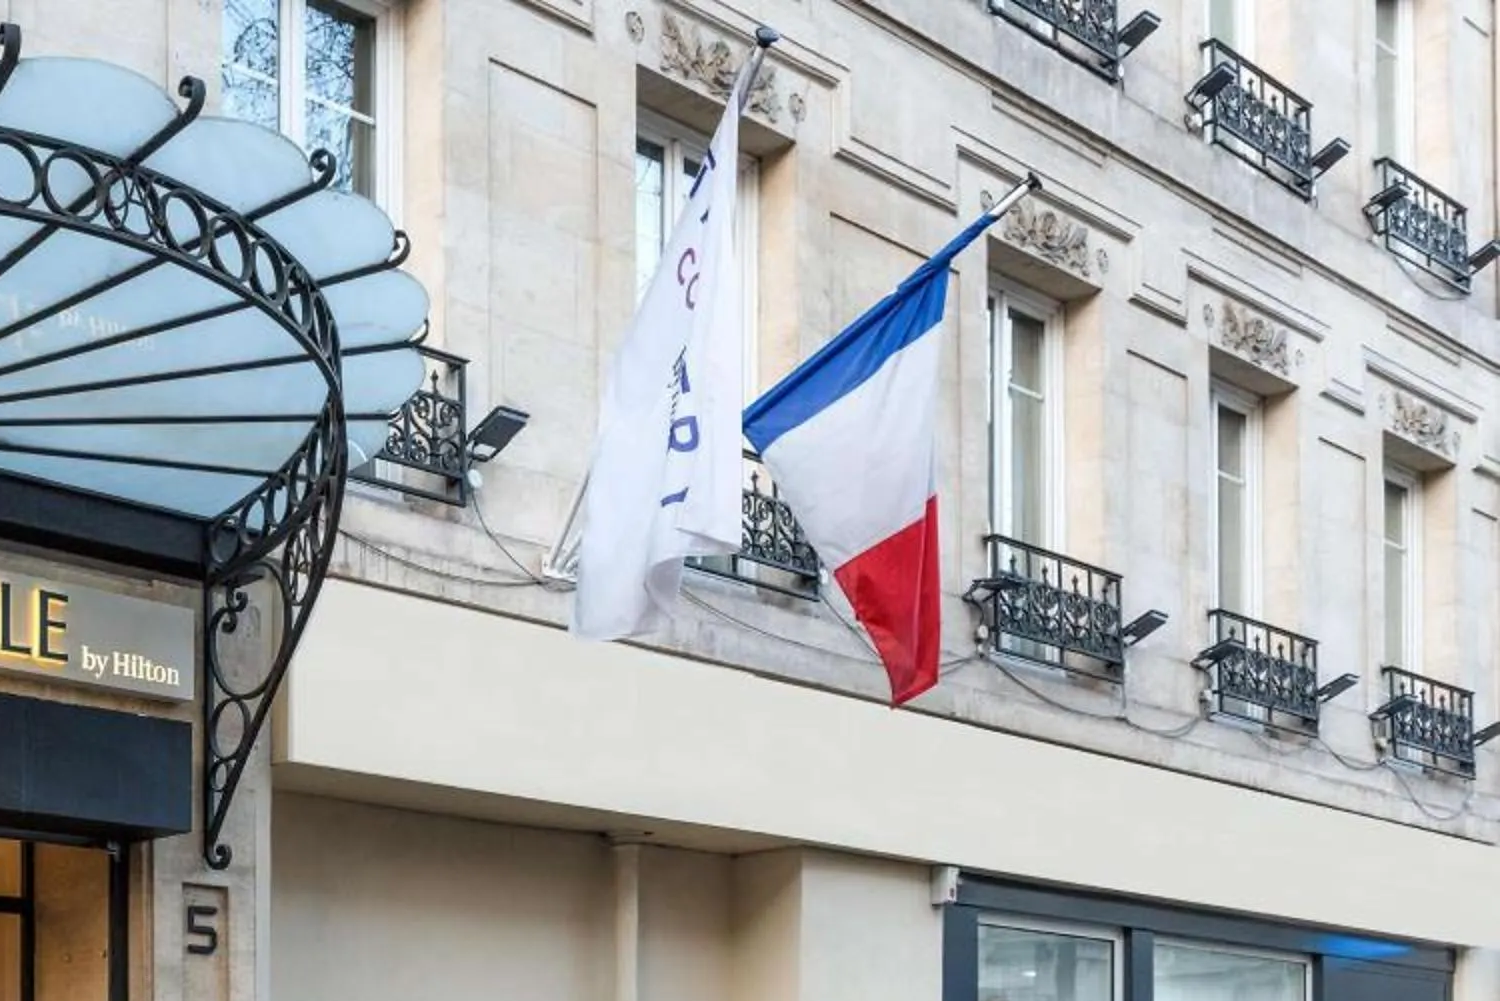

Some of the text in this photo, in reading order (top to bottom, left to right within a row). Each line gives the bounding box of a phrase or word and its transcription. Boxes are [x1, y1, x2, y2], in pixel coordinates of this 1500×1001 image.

[81, 645, 180, 686] by Hilton
[187, 905, 218, 955] 5
